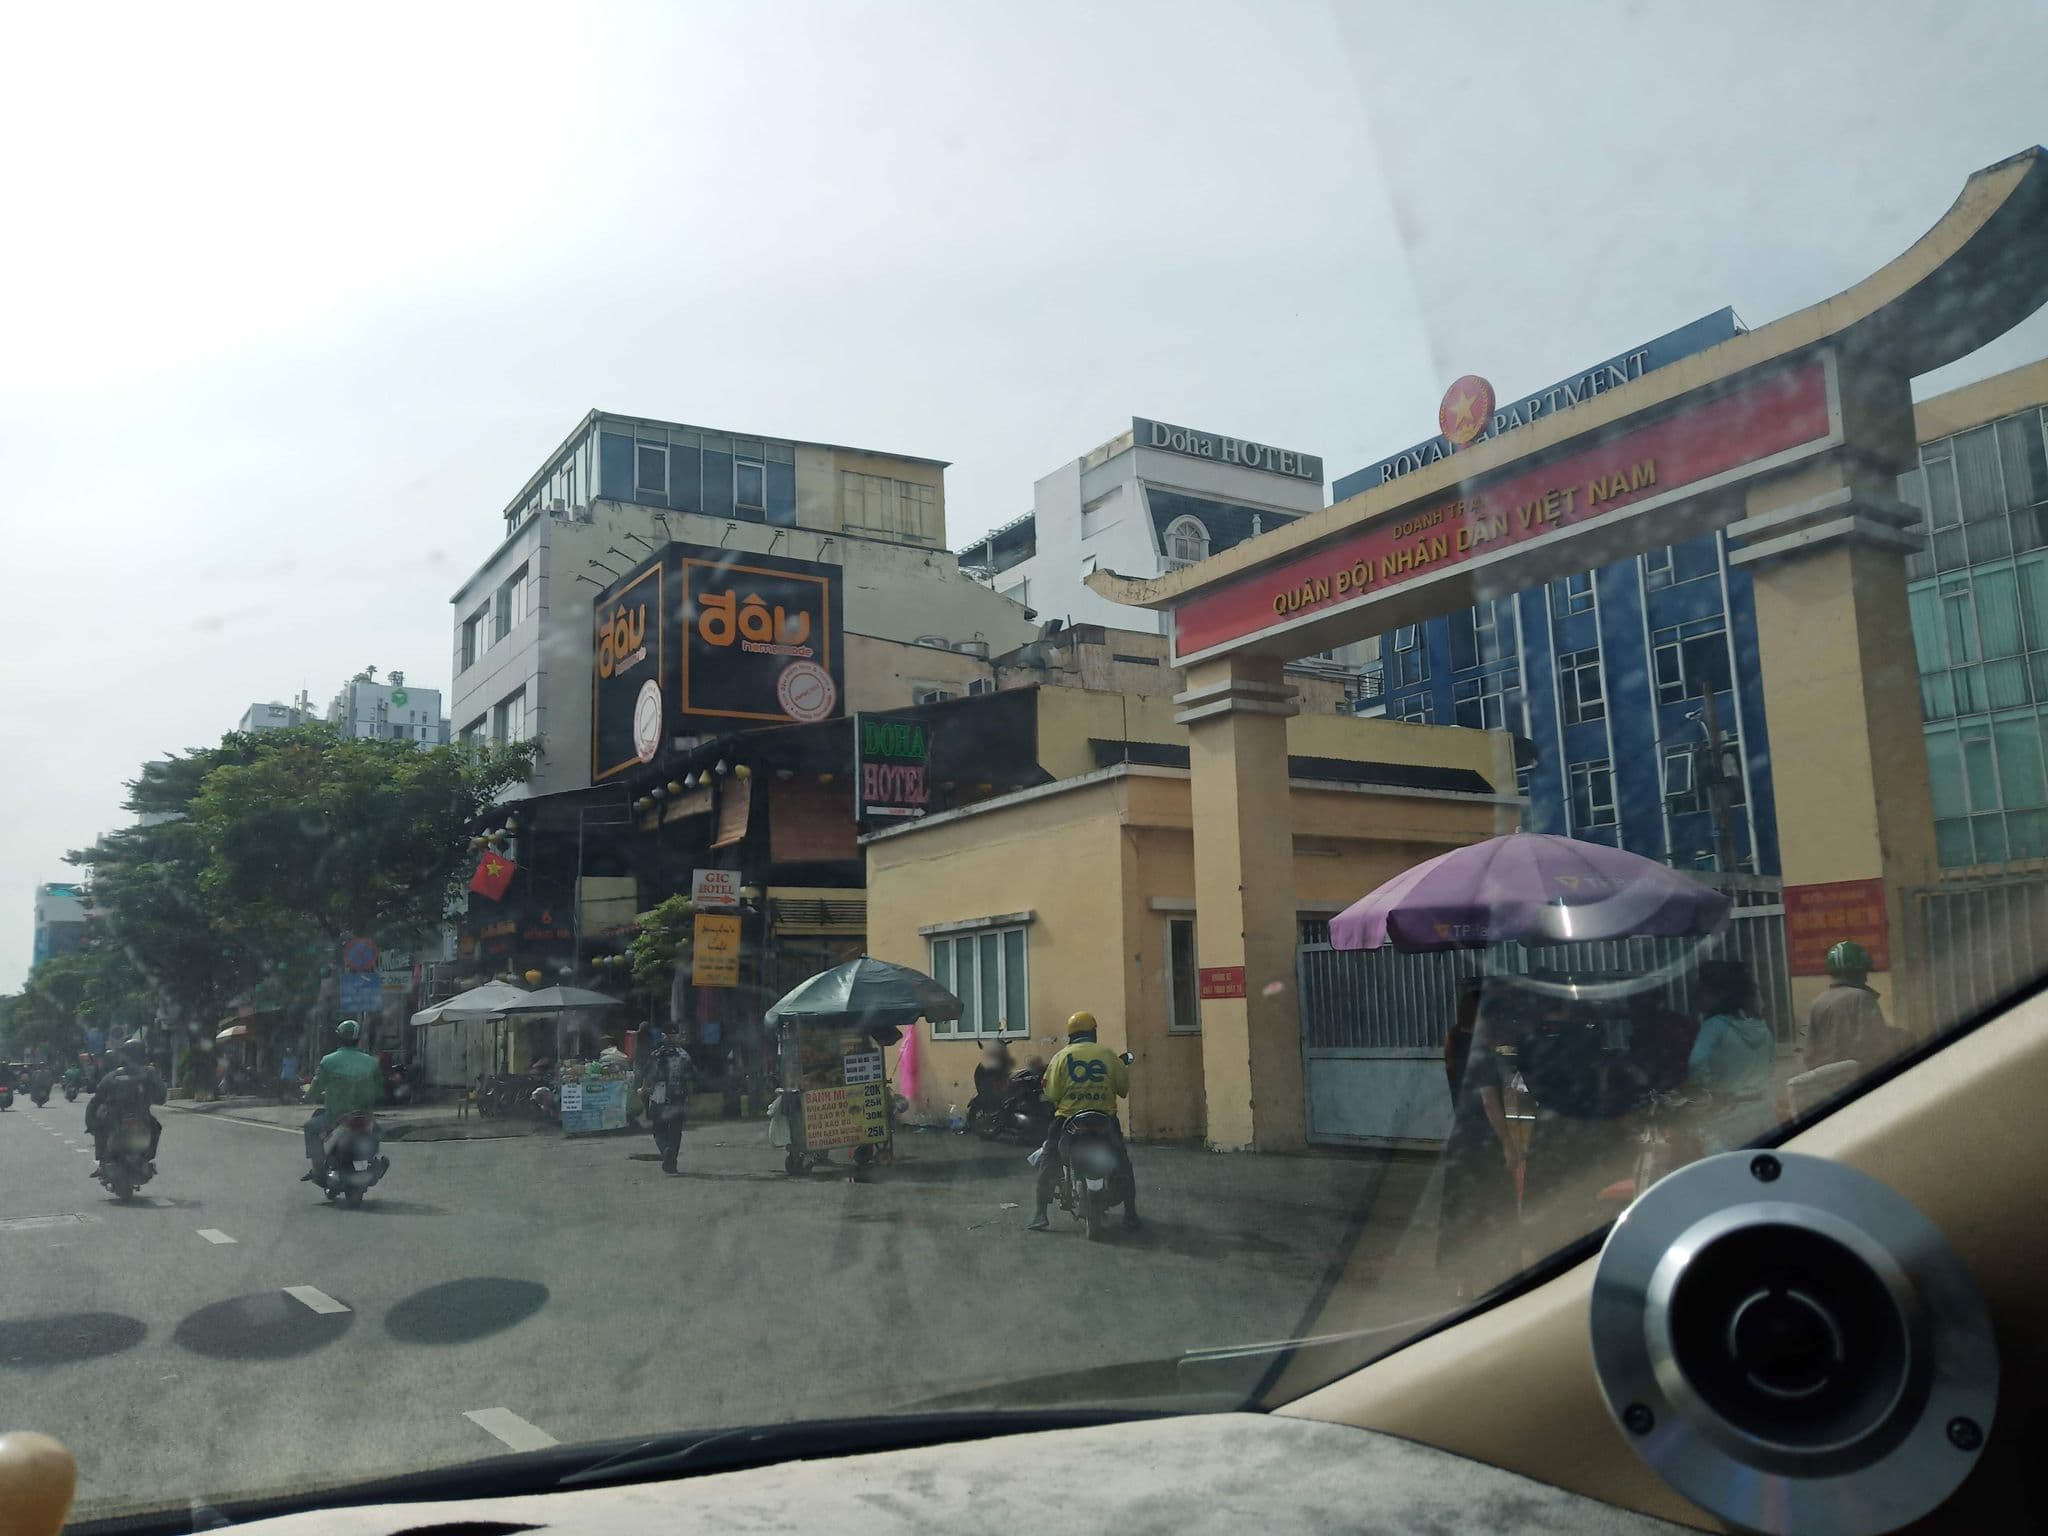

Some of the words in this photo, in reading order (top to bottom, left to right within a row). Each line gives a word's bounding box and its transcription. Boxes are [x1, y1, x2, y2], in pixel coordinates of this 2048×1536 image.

[1150, 421, 1212, 457] Doha
[1219, 436, 1313, 479] HOTEL
[1272, 577, 1330, 615] QUÂN
[1336, 558, 1374, 594] ĐỘI
[1381, 534, 1448, 577] NHÂN
[1456, 511, 1508, 552] DÂN
[1516, 486, 1579, 528] VIỆT
[1587, 457, 1656, 506] NAM
[1392, 509, 1444, 539] DOANH
[863, 721, 926, 758] DOHA
[862, 763, 929, 804] HOTEL
[699, 884, 734, 895] HOTEL
[1067, 1053, 1107, 1084] be
[864, 1085, 880, 1097] 20K
[864, 1098, 881, 1108] 25K
[865, 1111, 882, 1120] 30K
[867, 1126, 884, 1138] 25K
